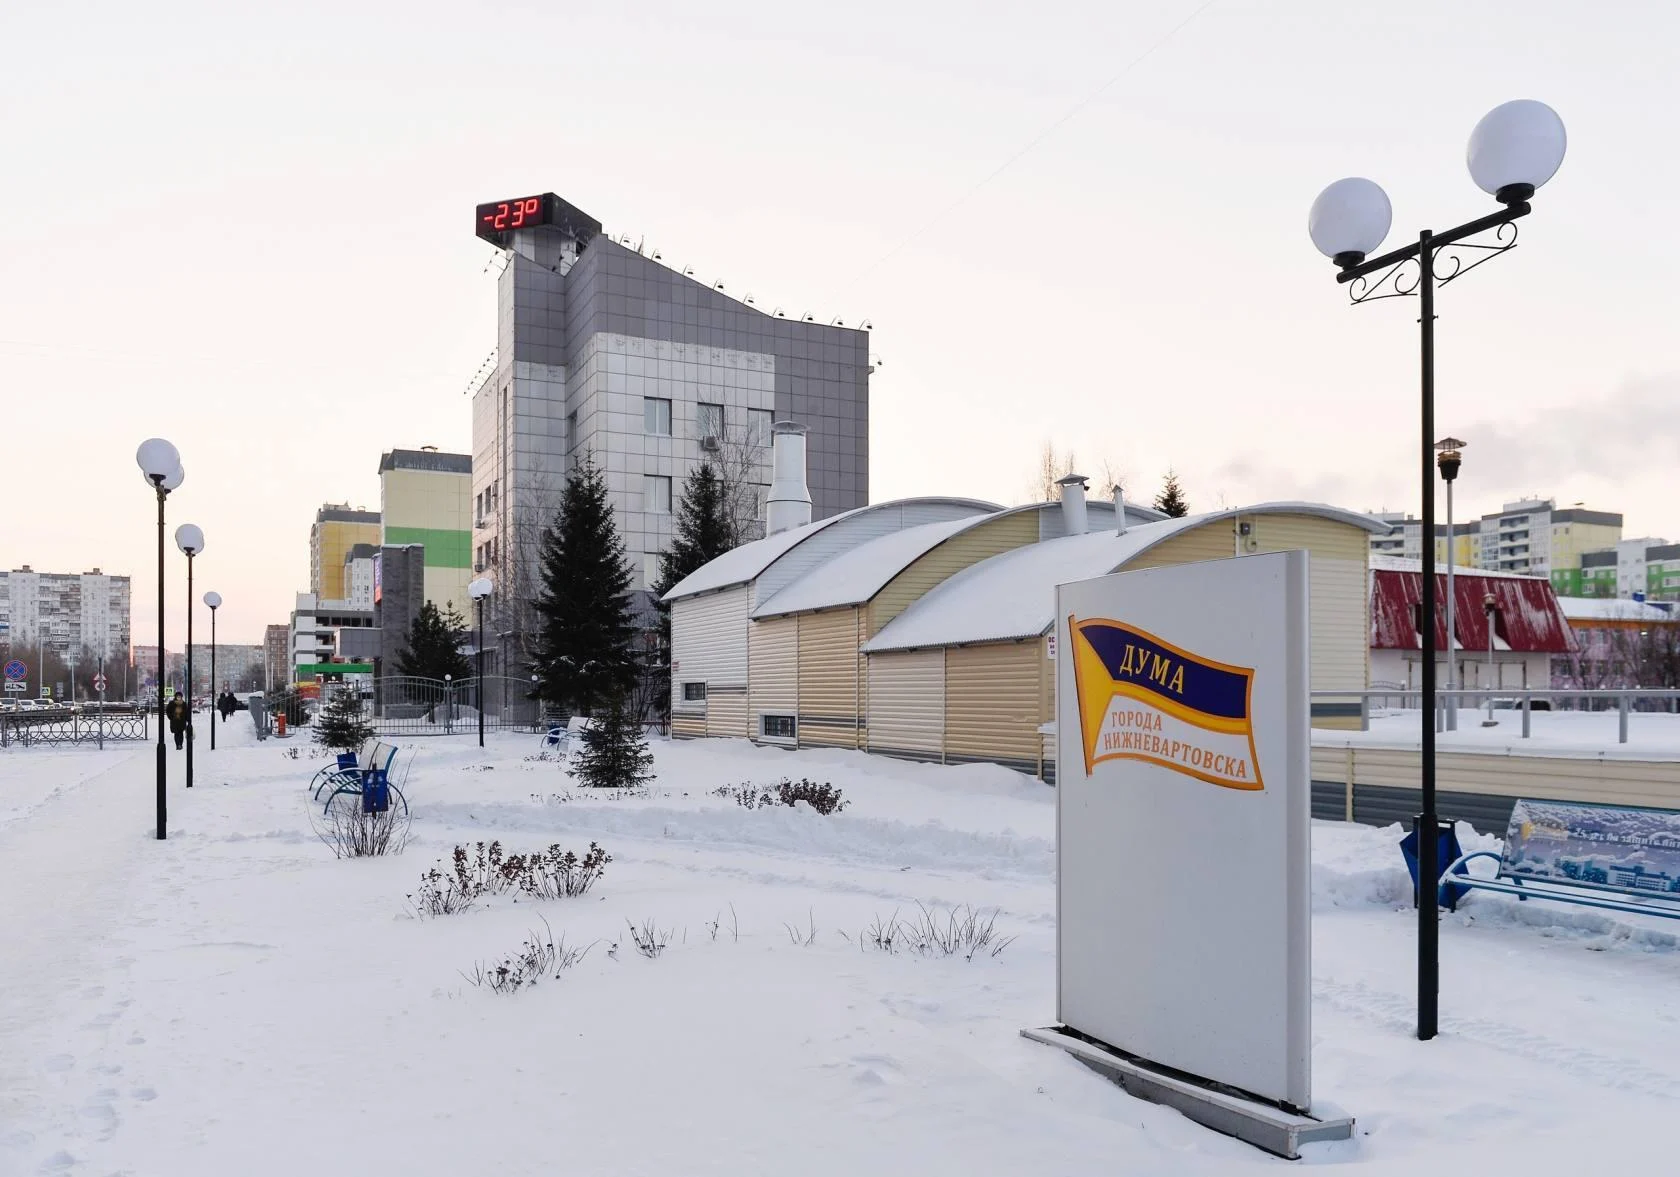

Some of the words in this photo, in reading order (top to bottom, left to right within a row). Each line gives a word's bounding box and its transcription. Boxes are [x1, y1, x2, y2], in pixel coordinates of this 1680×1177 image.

[1119, 644, 1184, 694] ДУМА
[1111, 711, 1162, 731] ГОРОДА
[1104, 734, 1247, 778] НИЖНЕВАРТОВСКА
